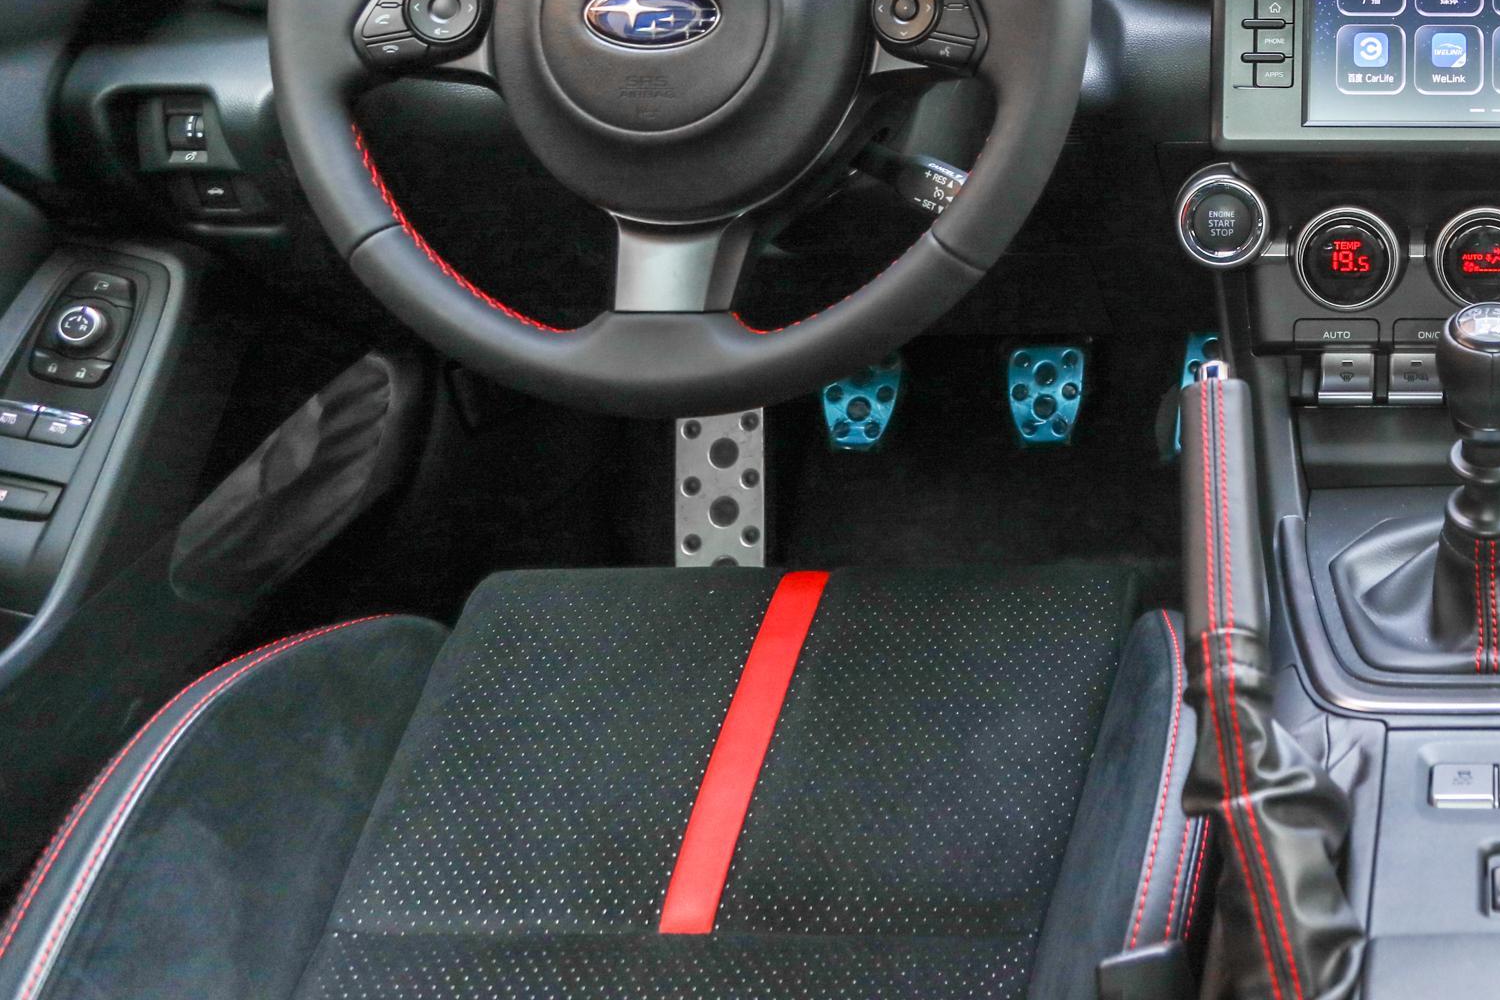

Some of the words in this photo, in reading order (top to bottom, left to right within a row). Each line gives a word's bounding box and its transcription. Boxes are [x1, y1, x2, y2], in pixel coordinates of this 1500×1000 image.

[1365, 73, 1394, 83] CarLife
[1432, 73, 1466, 83] WeLink
[933, 173, 948, 185] RES
[922, 199, 937, 211] SET
[1208, 210, 1235, 218] ENGINE
[1208, 219, 1236, 228] START
[1210, 228, 1234, 237] STOP
[1333, 241, 1361, 250] TEMP
[1332, 250, 1370, 272] 19.5
[1322, 331, 1351, 339] AUTO
